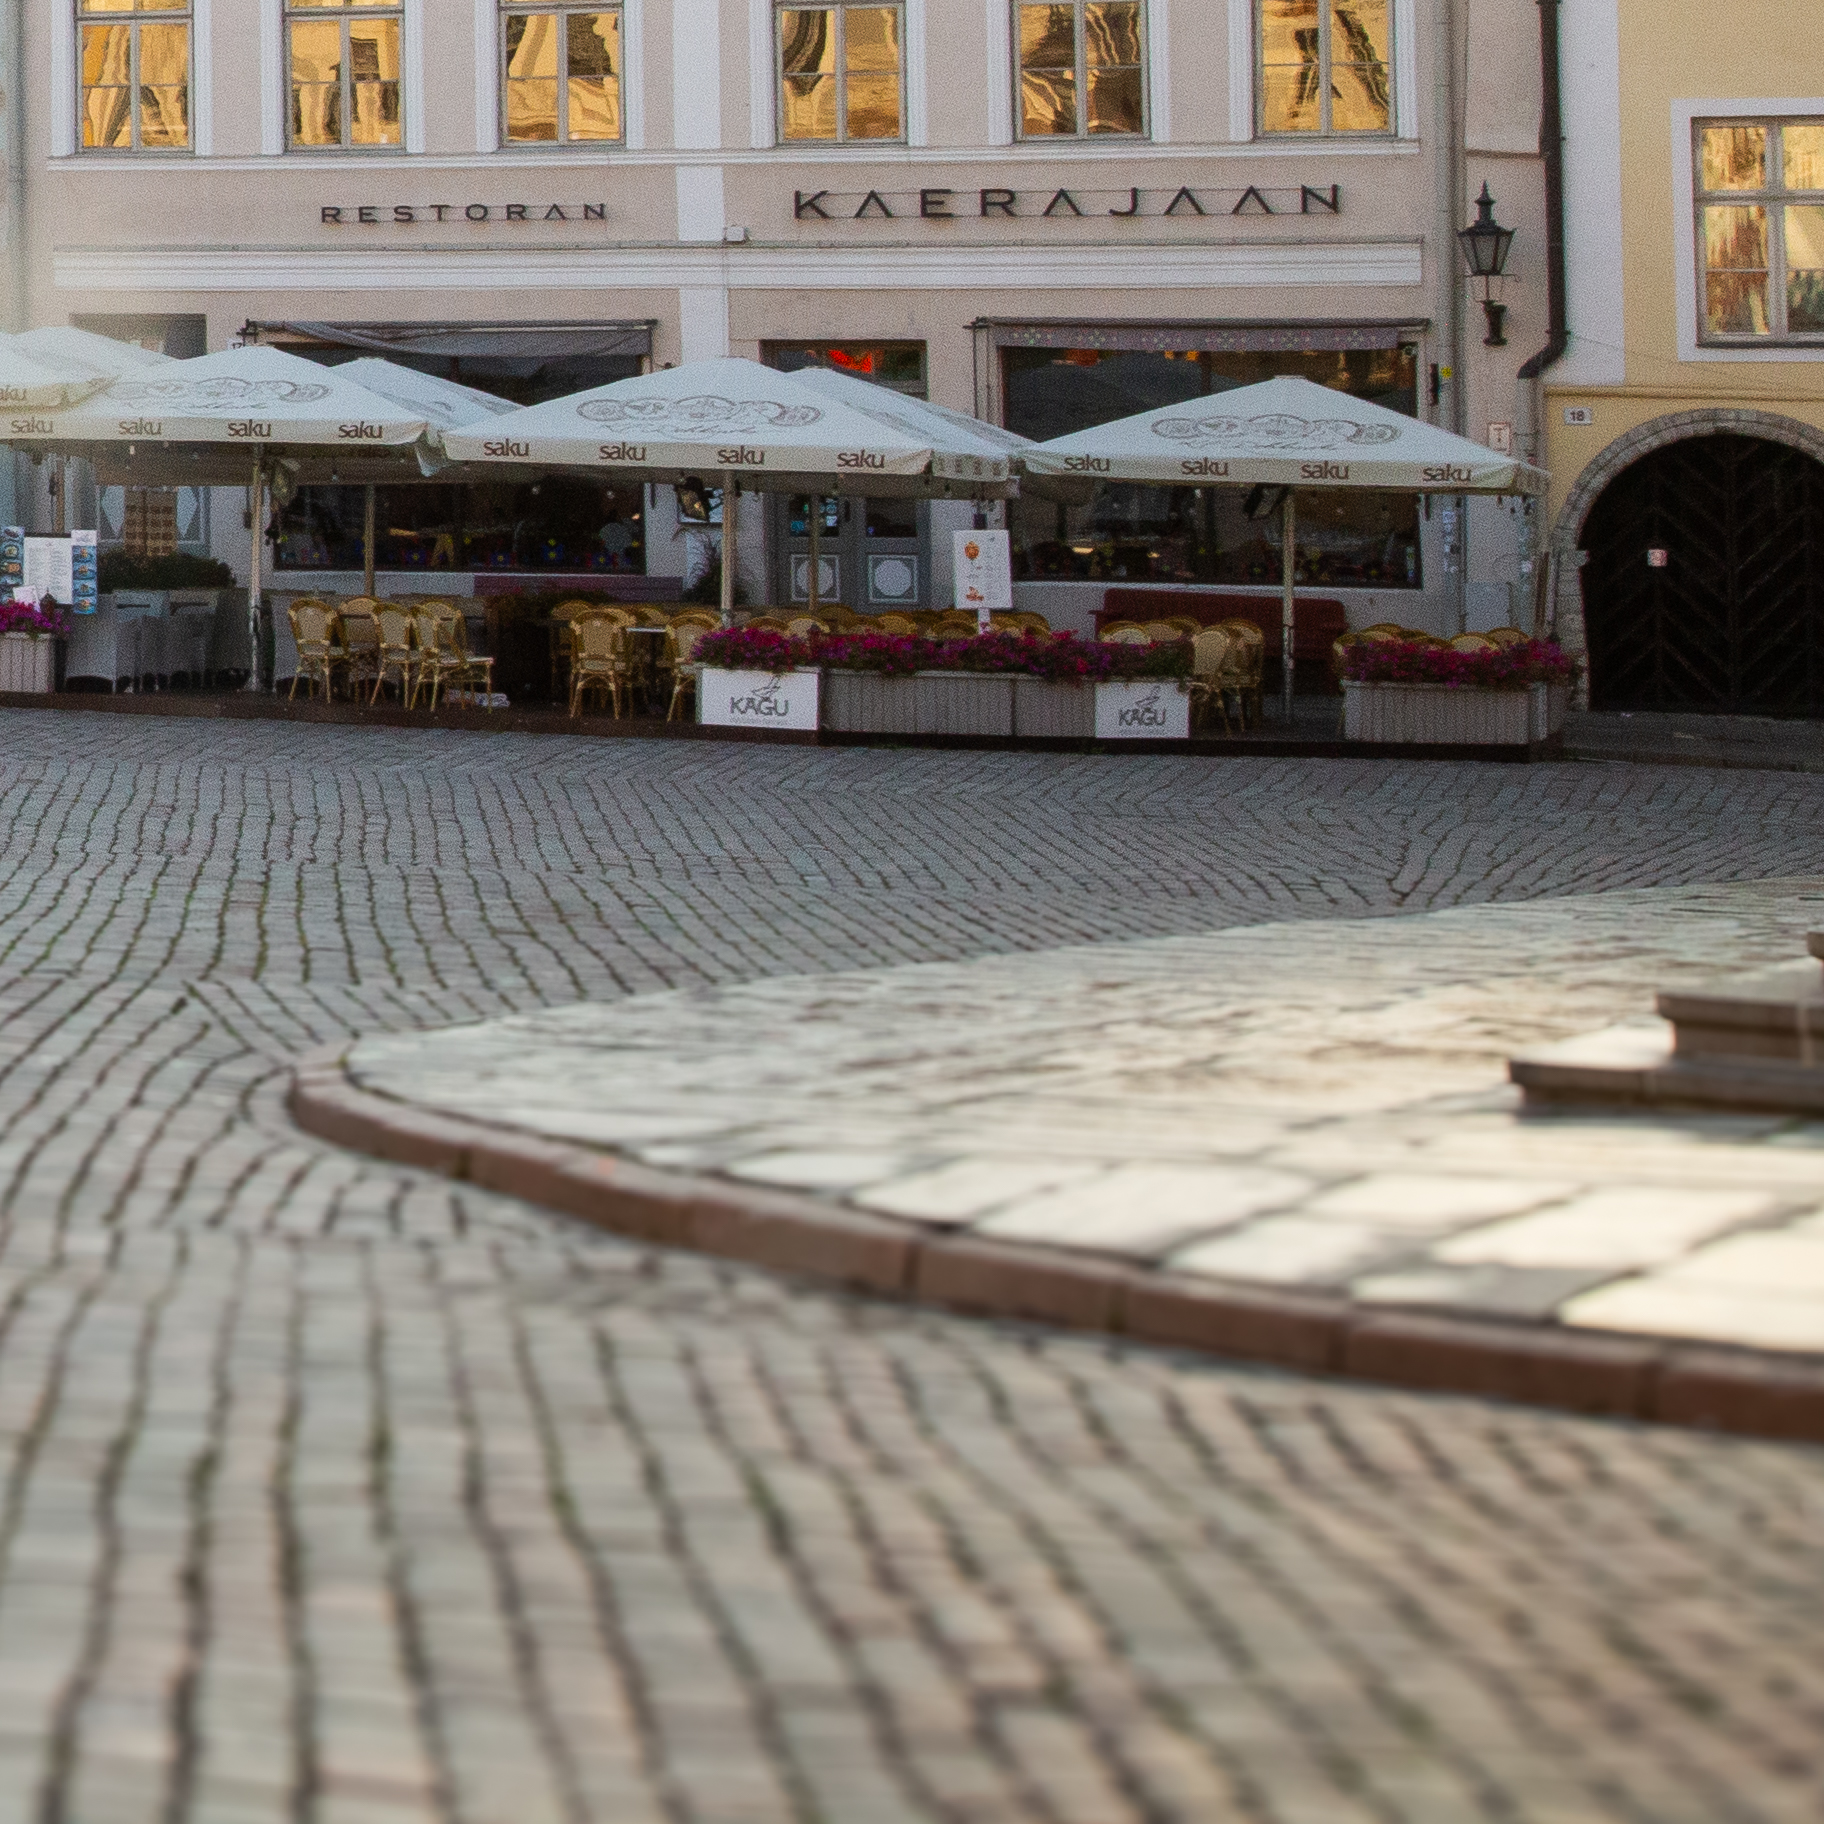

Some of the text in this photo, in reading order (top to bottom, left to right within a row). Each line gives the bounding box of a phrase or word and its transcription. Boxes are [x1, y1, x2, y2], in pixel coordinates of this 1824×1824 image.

[320, 184, 1342, 224] RESTORAN KAERAJAAN
[11, 416, 383, 439] saku saku saku saku
[1569, 410, 1586, 422] 18
[483, 437, 885, 470] saku saku saku saku
[1063, 453, 1473, 484] saku saku saku saku
[730, 696, 789, 717] KAGU
[1118, 708, 1167, 727] KAGU
